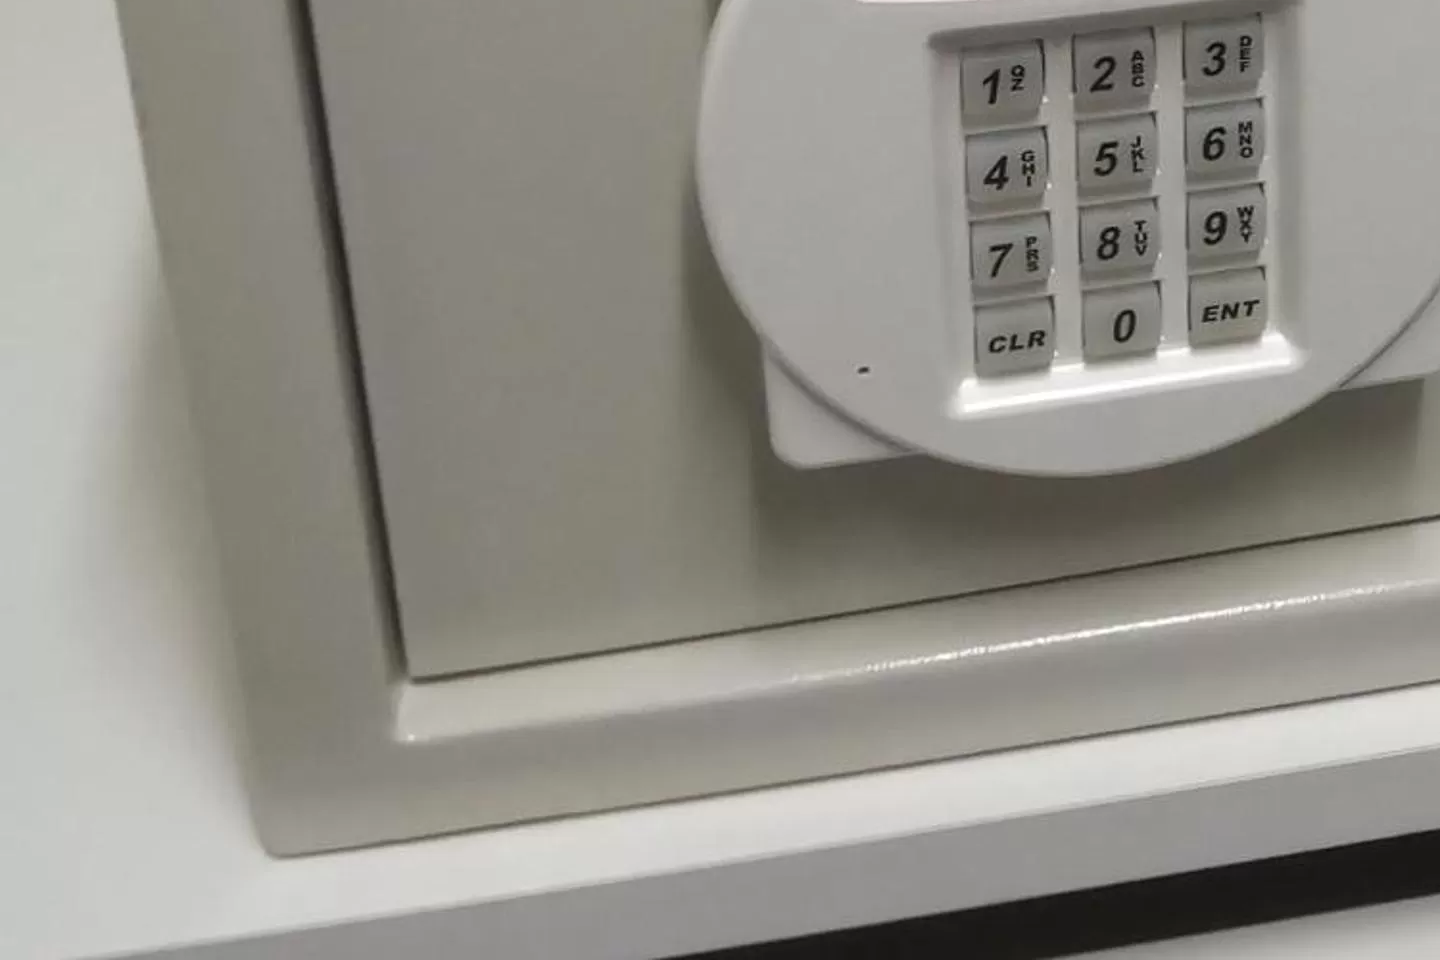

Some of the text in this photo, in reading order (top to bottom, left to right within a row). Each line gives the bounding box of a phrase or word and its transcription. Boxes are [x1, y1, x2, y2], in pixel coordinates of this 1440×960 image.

[1089, 56, 1117, 93] 2
[1202, 41, 1226, 76] 3
[982, 69, 1001, 105] 1
[1094, 142, 1118, 177] 5
[1202, 126, 1225, 161] 6
[983, 155, 1009, 190] 4
[1097, 226, 1120, 260] 8
[1203, 211, 1227, 245] 9
[988, 243, 1013, 278] 7
[1113, 309, 1136, 343] 0
[1201, 300, 1260, 323] ENT
[988, 329, 1046, 354] CLR
